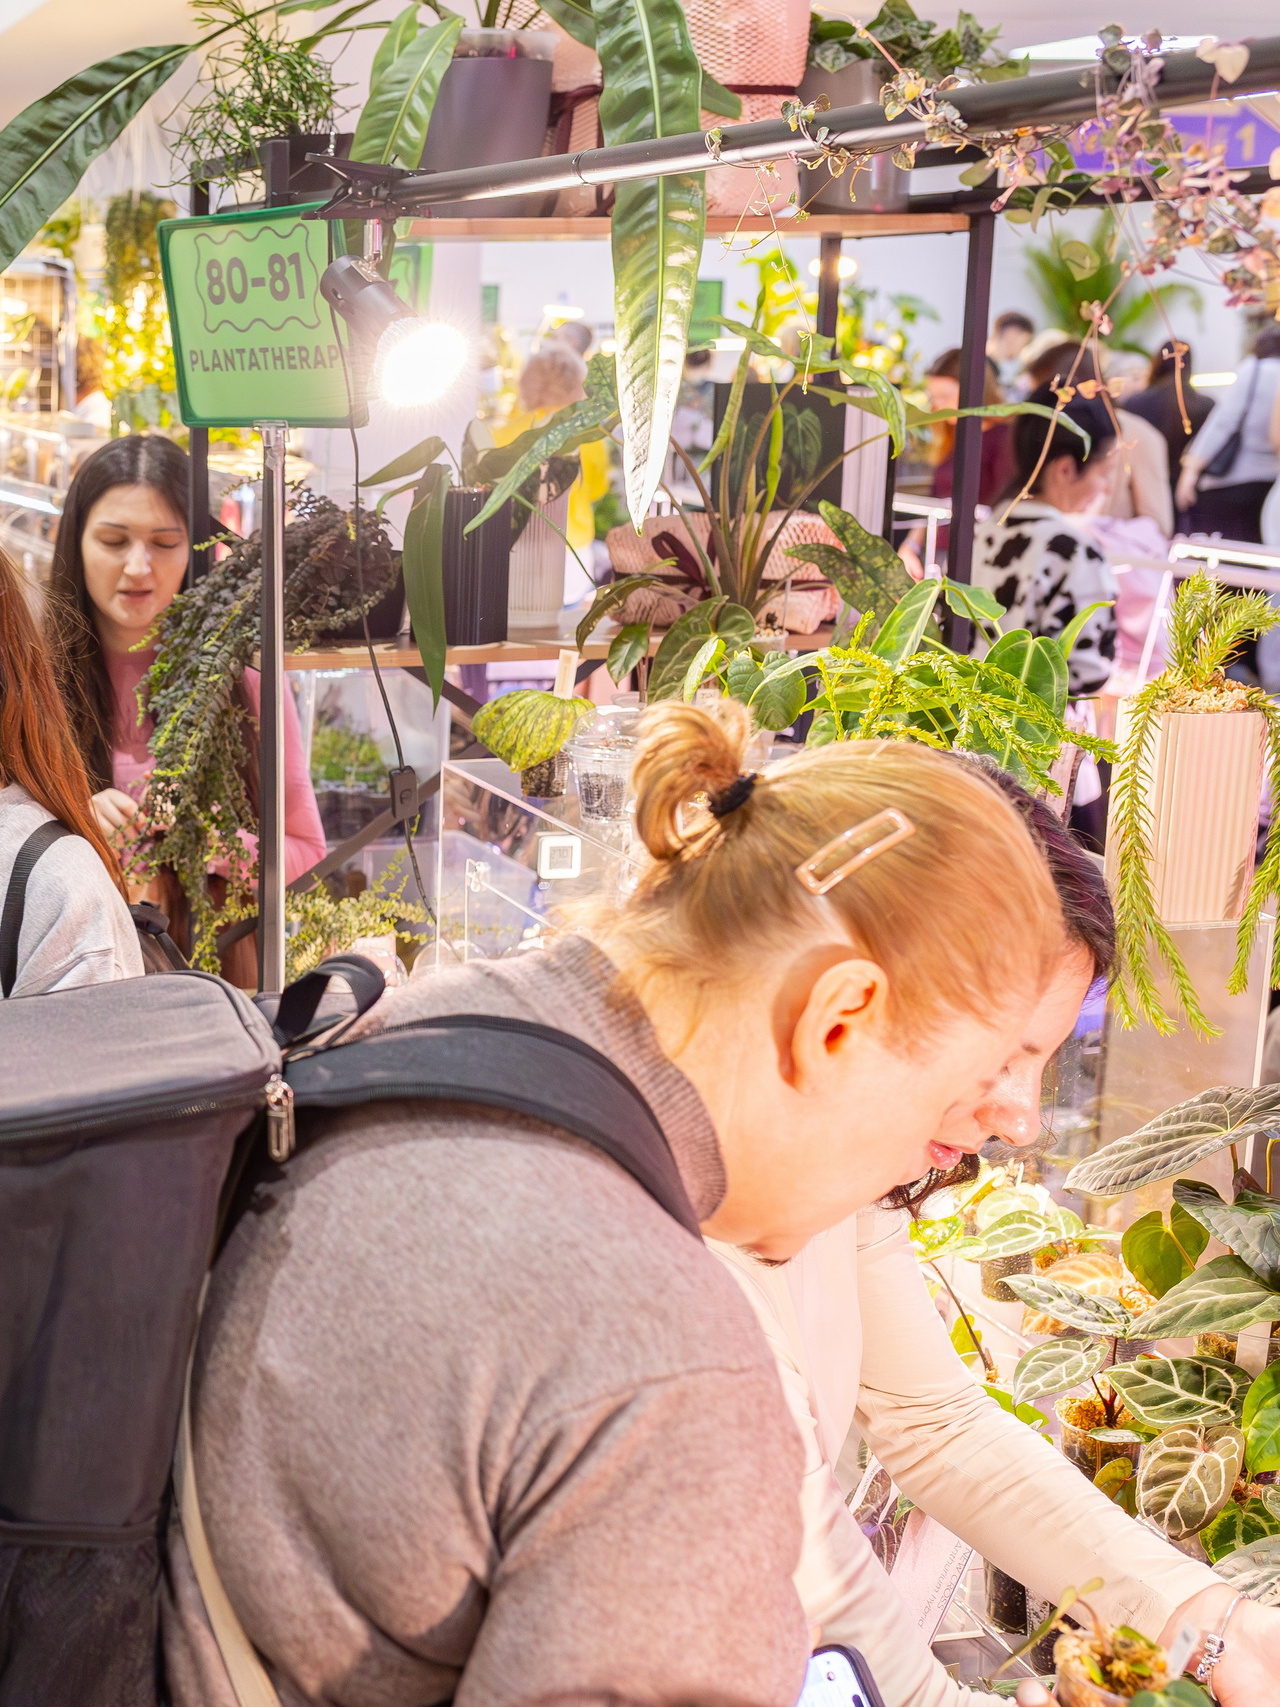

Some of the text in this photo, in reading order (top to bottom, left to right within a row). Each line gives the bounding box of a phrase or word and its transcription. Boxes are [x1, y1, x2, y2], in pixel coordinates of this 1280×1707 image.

[205, 251, 306, 306] 80-81
[189, 344, 348, 373] PLANTATHERAP
[917, 1540, 962, 1629] Anthurium hybrid
[936, 1546, 971, 1611] NEW CROSS
